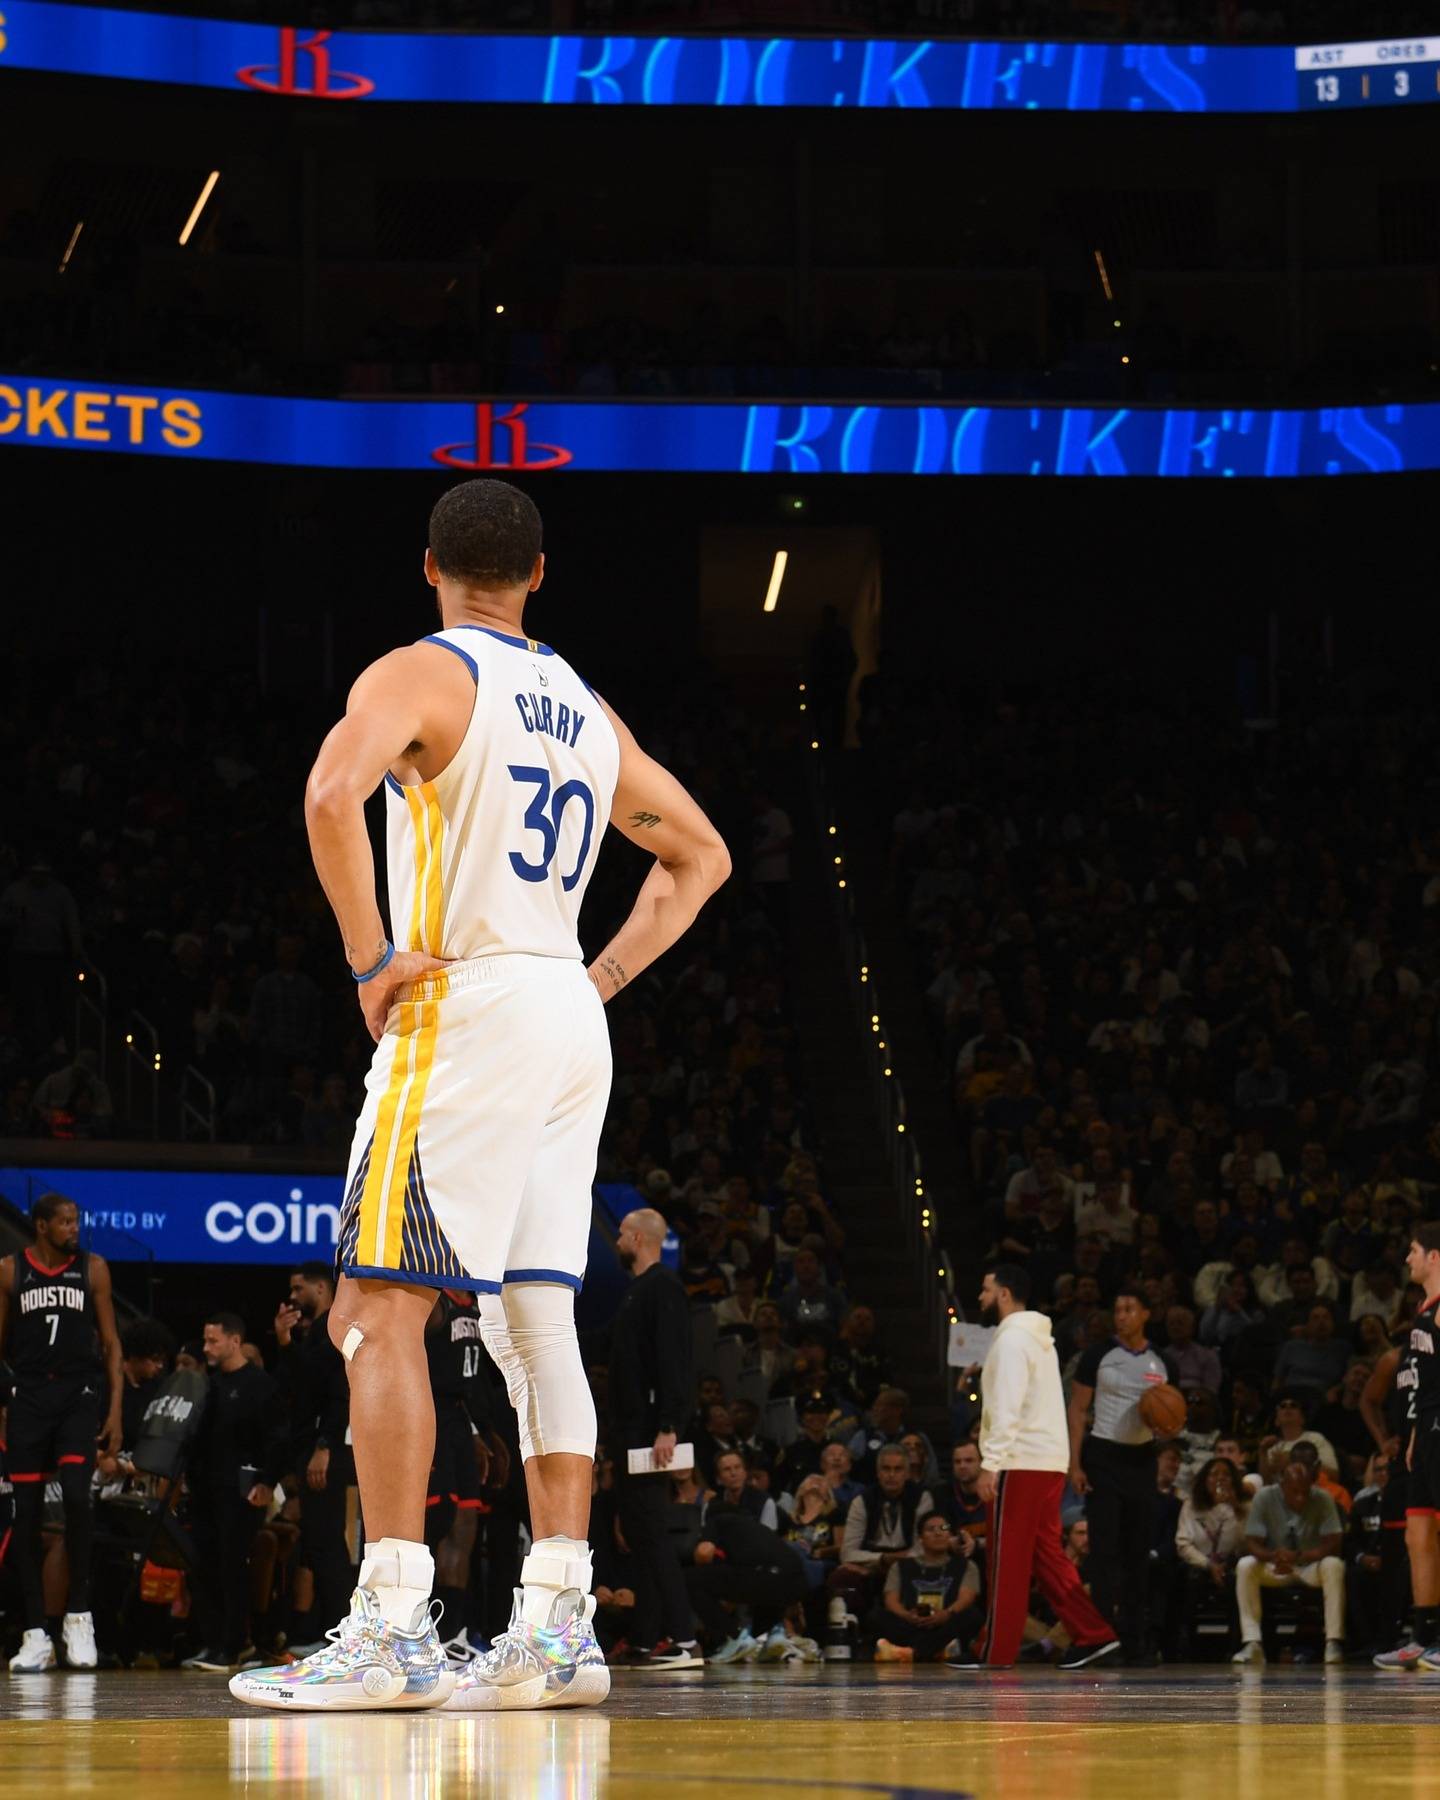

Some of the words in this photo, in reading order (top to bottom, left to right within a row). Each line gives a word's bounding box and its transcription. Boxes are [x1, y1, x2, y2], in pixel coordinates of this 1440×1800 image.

[1311, 50, 1343, 63] AST
[1377, 44, 1426, 60] OREB
[1315, 75, 1339, 102] 13
[1394, 70, 1410, 97] 3
[515, 693, 586, 749] CURRY
[506, 764, 595, 892] 30
[142, 1212, 167, 1229] BY
[20, 1285, 85, 1315] HOUSTON
[45, 1314, 60, 1346] 7
